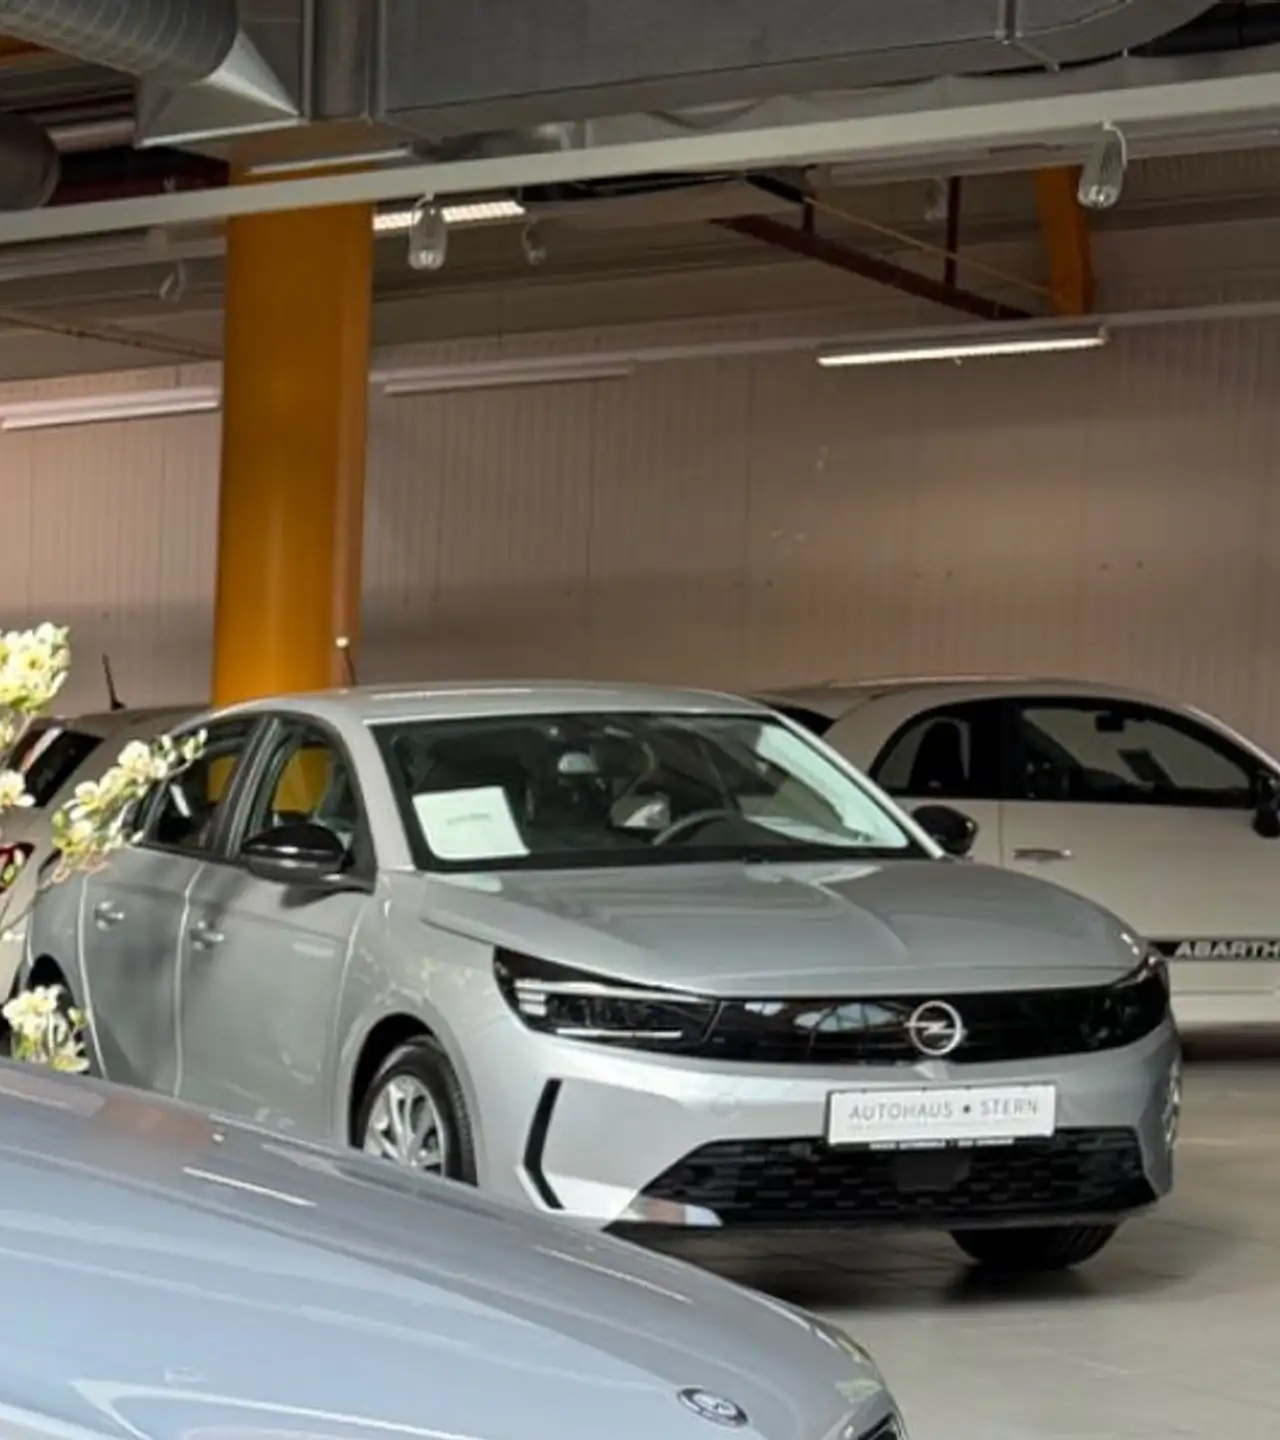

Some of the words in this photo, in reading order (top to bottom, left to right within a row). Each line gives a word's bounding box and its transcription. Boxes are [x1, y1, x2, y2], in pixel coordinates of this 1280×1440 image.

[1174, 940, 1280, 958] ABARTH
[848, 1102, 954, 1122] AUTOHAUS
[980, 1097, 1038, 1118] STERN
